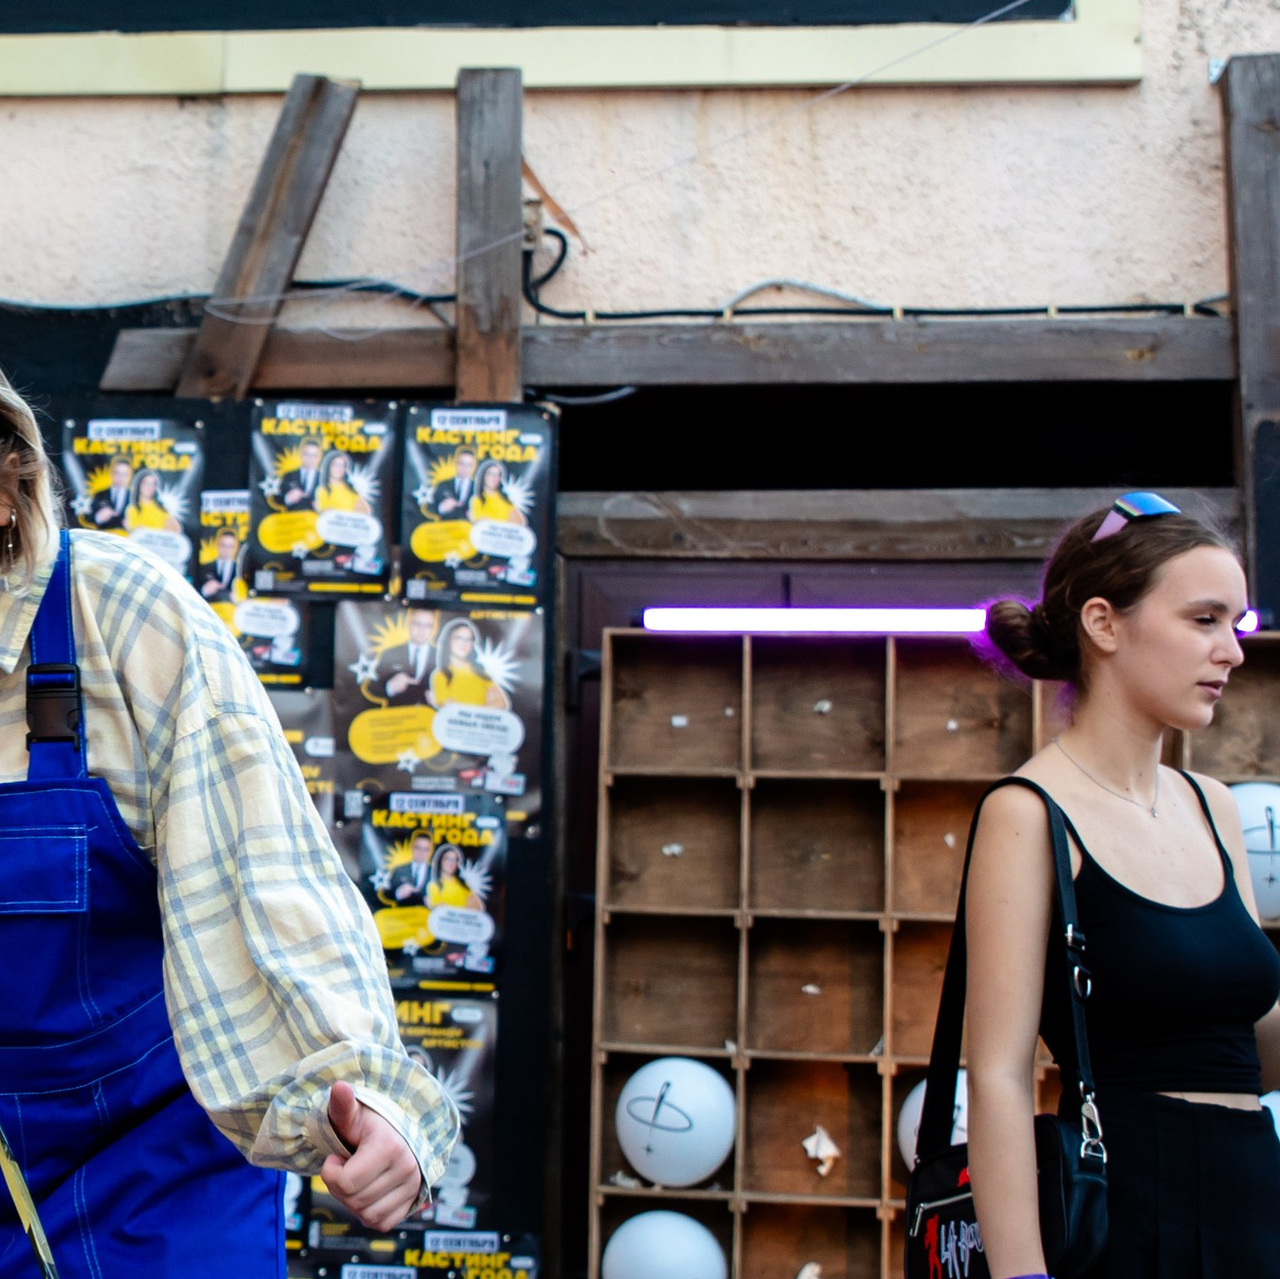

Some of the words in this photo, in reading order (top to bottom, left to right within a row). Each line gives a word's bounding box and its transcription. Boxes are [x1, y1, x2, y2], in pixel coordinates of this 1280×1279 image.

[261, 418, 365, 436] КАСТИНГ
[416, 426, 520, 444] КАСТИНГ
[73, 437, 175, 455] КАСТИНГ
[321, 434, 383, 453] ГОДА
[132, 453, 191, 471] ГОДА
[476, 444, 537, 462] ГОДА
[372, 809, 477, 829] КАСТИНГ
[433, 828, 495, 847] ГОДА
[404, 1248, 510, 1269] КАСТИНГ
